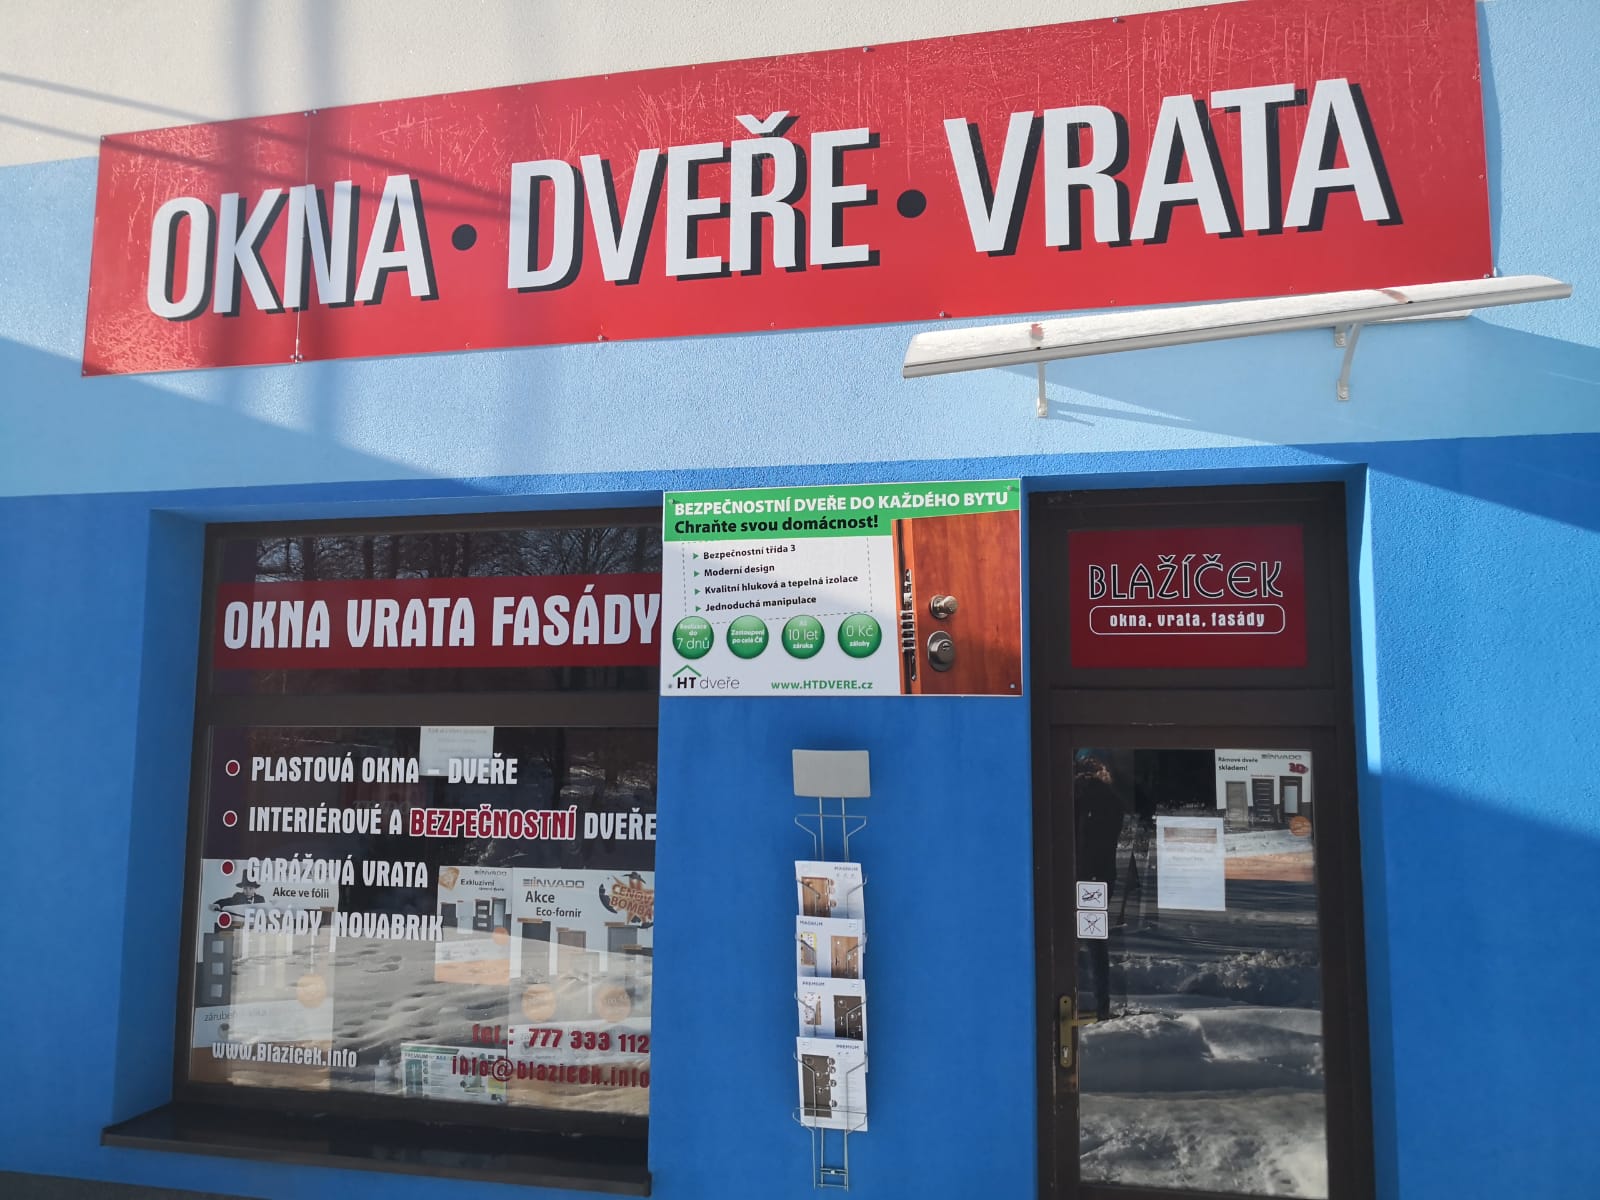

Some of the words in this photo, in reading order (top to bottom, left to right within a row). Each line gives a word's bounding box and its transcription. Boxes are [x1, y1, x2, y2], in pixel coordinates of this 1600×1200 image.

[146, 173, 436, 321] OKNA
[507, 110, 878, 292] DVEŘE
[943, 78, 1401, 256] VRATA
[674, 496, 791, 516] BEZPEČNOSTNÍ
[794, 495, 847, 512] DVEŘE
[850, 496, 875, 510] DO
[878, 491, 960, 509] KAŽDÉHO
[963, 491, 1008, 506] BYTU
[674, 519, 737, 534] Chraňte
[740, 520, 778, 532] svou
[782, 515, 879, 531] domácnost!
[703, 546, 764, 560] Bezpečnostní
[765, 545, 788, 554] třída
[790, 544, 796, 552] 3
[704, 566, 742, 577] Moderní
[744, 564, 775, 575] design
[1088, 553, 1283, 599] BLAŽÍČEK
[705, 583, 740, 594] Kvalitní
[742, 580, 778, 592] hluková
[788, 577, 824, 588] tepelná
[825, 575, 858, 584] izolace
[705, 599, 761, 612] Jednoduchá
[762, 596, 817, 608] manipulace
[223, 600, 330, 650] OKNA
[346, 597, 475, 648] VRATA
[492, 584, 660, 646] FASÁDY
[1109, 613, 1153, 628] okna,
[1157, 612, 1206, 628] vrata,
[1211, 611, 1265, 628] fasády
[788, 629, 800, 641] 10
[803, 628, 819, 640] let
[846, 625, 855, 637] 0
[858, 625, 874, 637] Kč
[676, 637, 683, 649] 7
[686, 637, 710, 649] dnů
[677, 677, 697, 689] HT
[699, 676, 740, 689] dveře
[771, 680, 873, 690] www.HTDVERE.cz
[251, 751, 354, 783] PLASTOVÁ
[361, 757, 419, 784] OKNA
[448, 752, 518, 785] DVEŘE
[249, 802, 382, 835] INTERIÉROVÉ
[389, 808, 402, 835] A
[409, 803, 577, 840] BEZPEČNOSTNÍ
[583, 807, 656, 840] DVEŘE
[247, 853, 354, 885] GARÁŽOVÁ
[362, 860, 428, 888] VRATA
[272, 887, 296, 897] Akce
[298, 889, 309, 897] ve
[311, 888, 329, 899] fólii
[525, 891, 555, 903] Akce
[335, 911, 443, 942] NOVABRIK
[528, 1028, 563, 1048] 777
[570, 1030, 610, 1051] 333
[618, 1033, 649, 1054] 112
[212, 1042, 357, 1068] www.Blazicek.info
